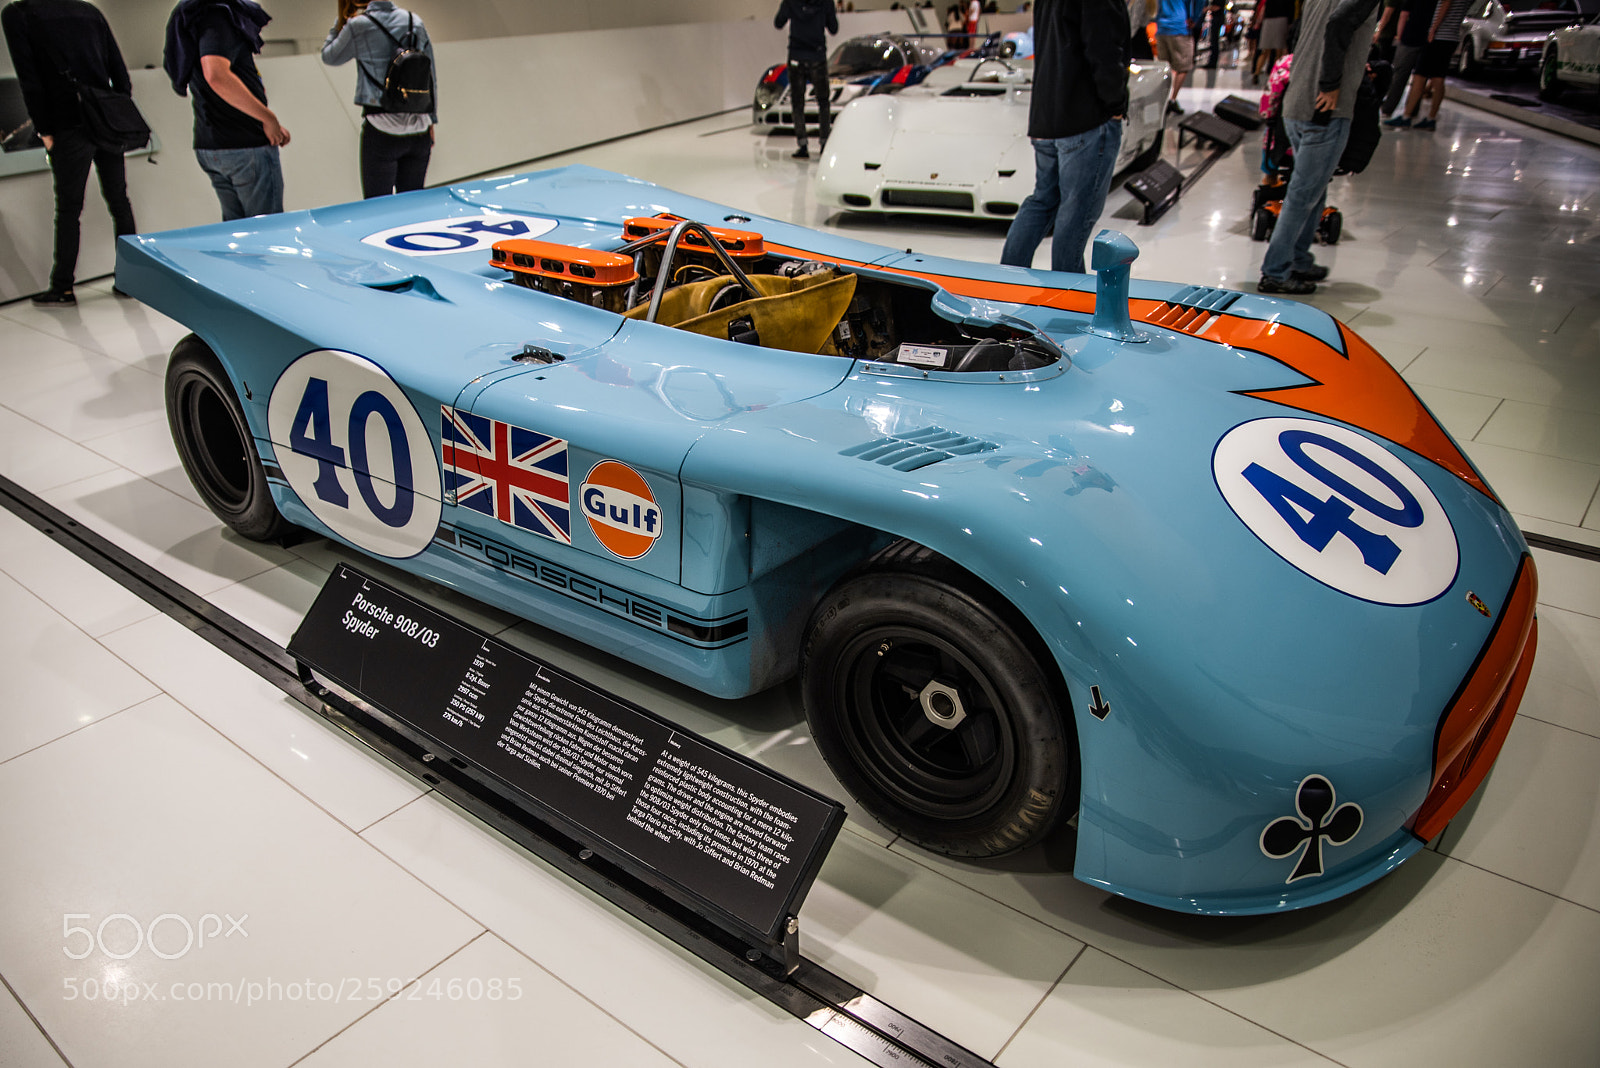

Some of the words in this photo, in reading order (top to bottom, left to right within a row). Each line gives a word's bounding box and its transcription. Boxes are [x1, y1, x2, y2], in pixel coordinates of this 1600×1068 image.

[385, 220, 530, 251] 40
[289, 376, 414, 528] 40
[583, 487, 658, 533] Gulf
[1241, 429, 1425, 576] 40
[458, 531, 662, 628] PORSCHE
[342, 610, 379, 639] Spyder
[351, 592, 393, 624] Porsche
[393, 615, 440, 648] 908/03
[458, 702, 466, 710] PS
[468, 692, 478, 700] ccm
[647, 774, 665, 787] grams.
[676, 789, 693, 801] driver
[714, 809, 733, 822] engine
[743, 824, 764, 838] moved
[763, 833, 787, 850] forward
[672, 756, 690, 769] weight
[736, 787, 748, 798] this
[748, 793, 769, 808] Spyder
[769, 805, 798, 823] embodies
[678, 780, 698, 793] plastic
[697, 788, 712, 801] body
[756, 820, 772, 832] mere
[780, 831, 794, 842] kilo-
[749, 805, 763, 816] with
[773, 816, 791, 829] foam-
[626, 813, 646, 828] behind
[654, 830, 671, 843] wheel.
[631, 805, 646, 818] Targa
[645, 813, 661, 826] Florio
[683, 835, 696, 846] with
[703, 845, 722, 860] Siffert
[733, 861, 750, 875] Brian
[749, 870, 774, 889] Redman
[635, 797, 650, 810] those
[650, 805, 662, 816] four
[710, 840, 737, 857] premiere
[743, 856, 759, 869] 1970
[648, 794, 671, 810] 908/03
[669, 805, 689, 820] Spyder
[689, 817, 702, 828] only
[701, 822, 714, 833] four
[742, 845, 756, 857] wins
[756, 852, 773, 865] three
[650, 786, 673, 801] optimize
[673, 798, 691, 811] weight
[736, 830, 758, 847] factory
[757, 841, 773, 854] team
[773, 851, 790, 863] races
